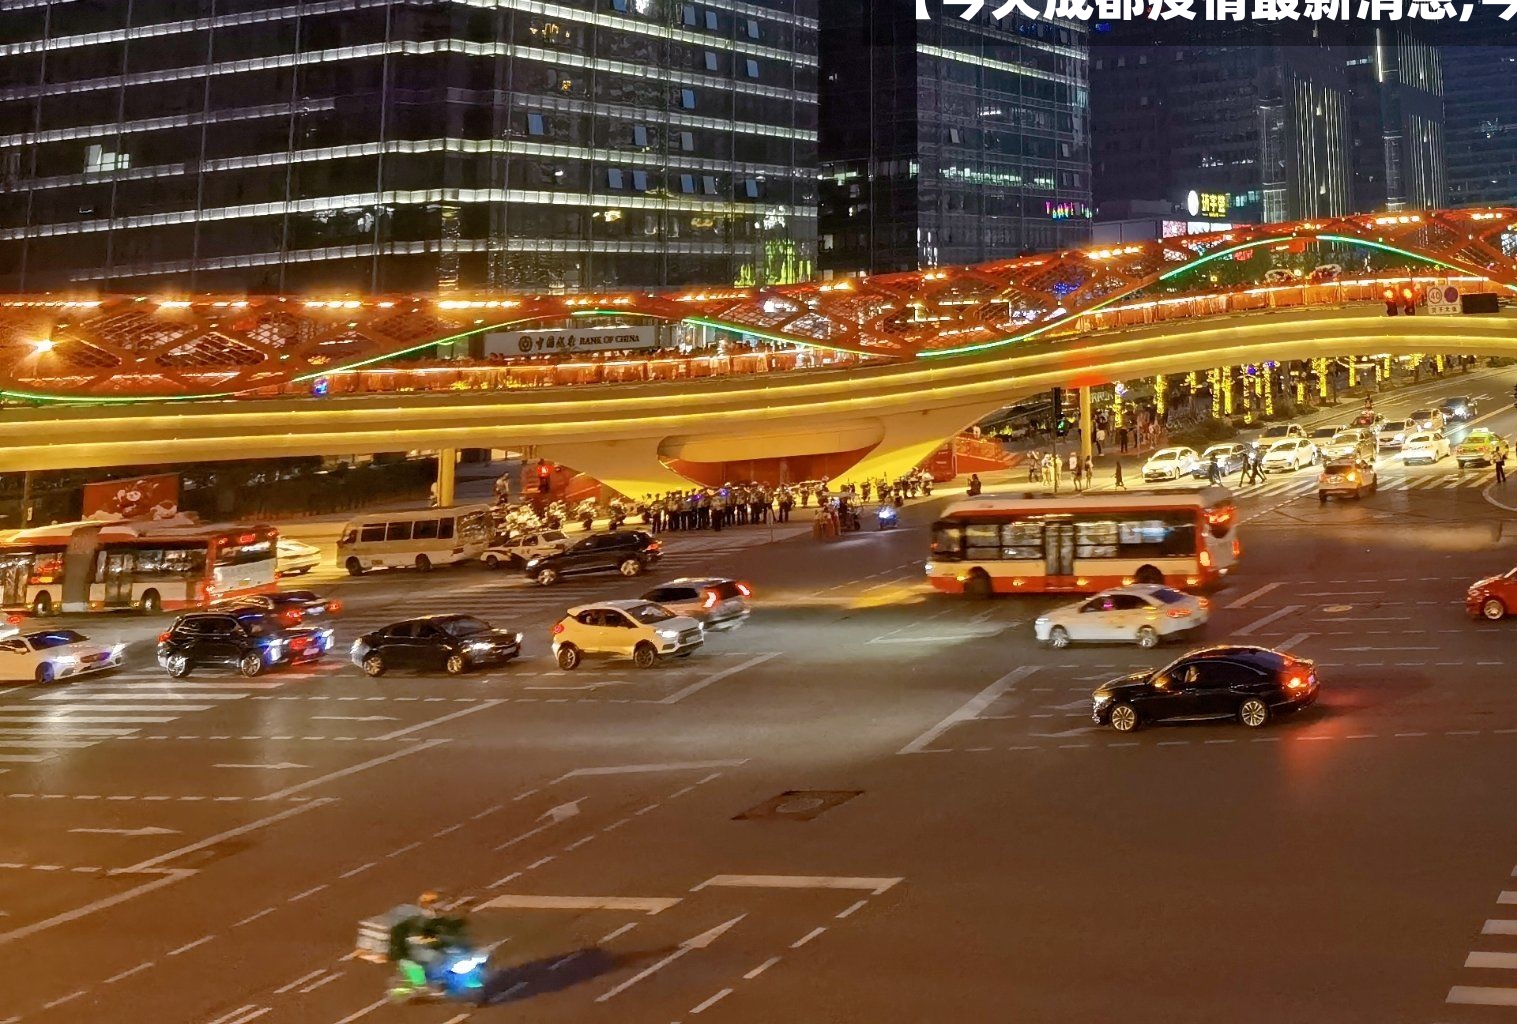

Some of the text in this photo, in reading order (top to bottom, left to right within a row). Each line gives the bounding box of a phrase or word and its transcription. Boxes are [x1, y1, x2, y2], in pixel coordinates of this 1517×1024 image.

[579, 334, 640, 345] BANK OF CHINA
